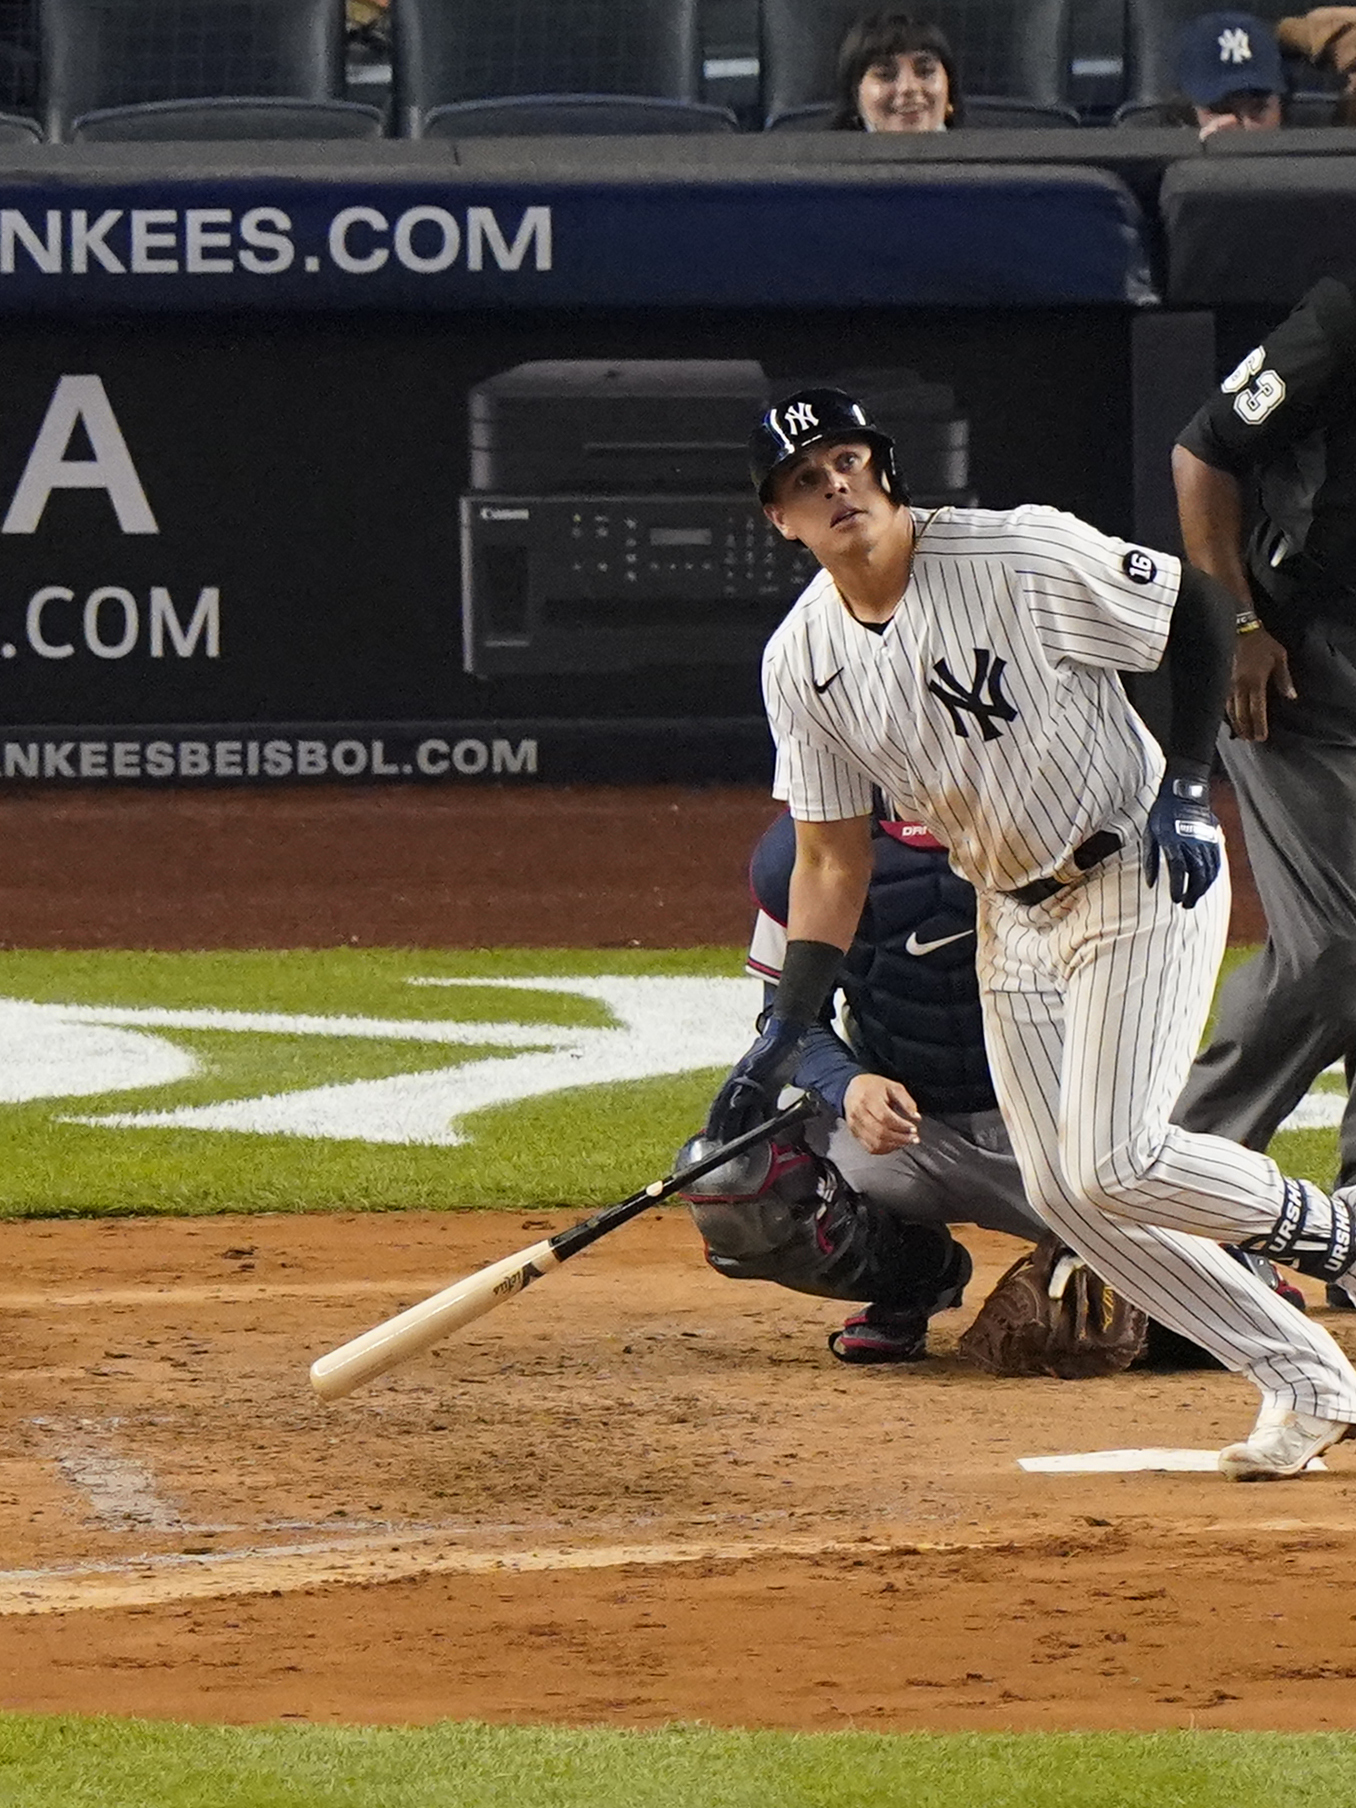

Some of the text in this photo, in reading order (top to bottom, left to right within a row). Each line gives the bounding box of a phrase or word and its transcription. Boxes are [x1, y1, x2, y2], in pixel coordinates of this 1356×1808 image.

[0, 205, 553, 274] NKEES.COM
[1, 374, 160, 534] A
[1129, 553, 1152, 580] 16
[0, 585, 220, 659] .COM
[929, 647, 1018, 742] NY
